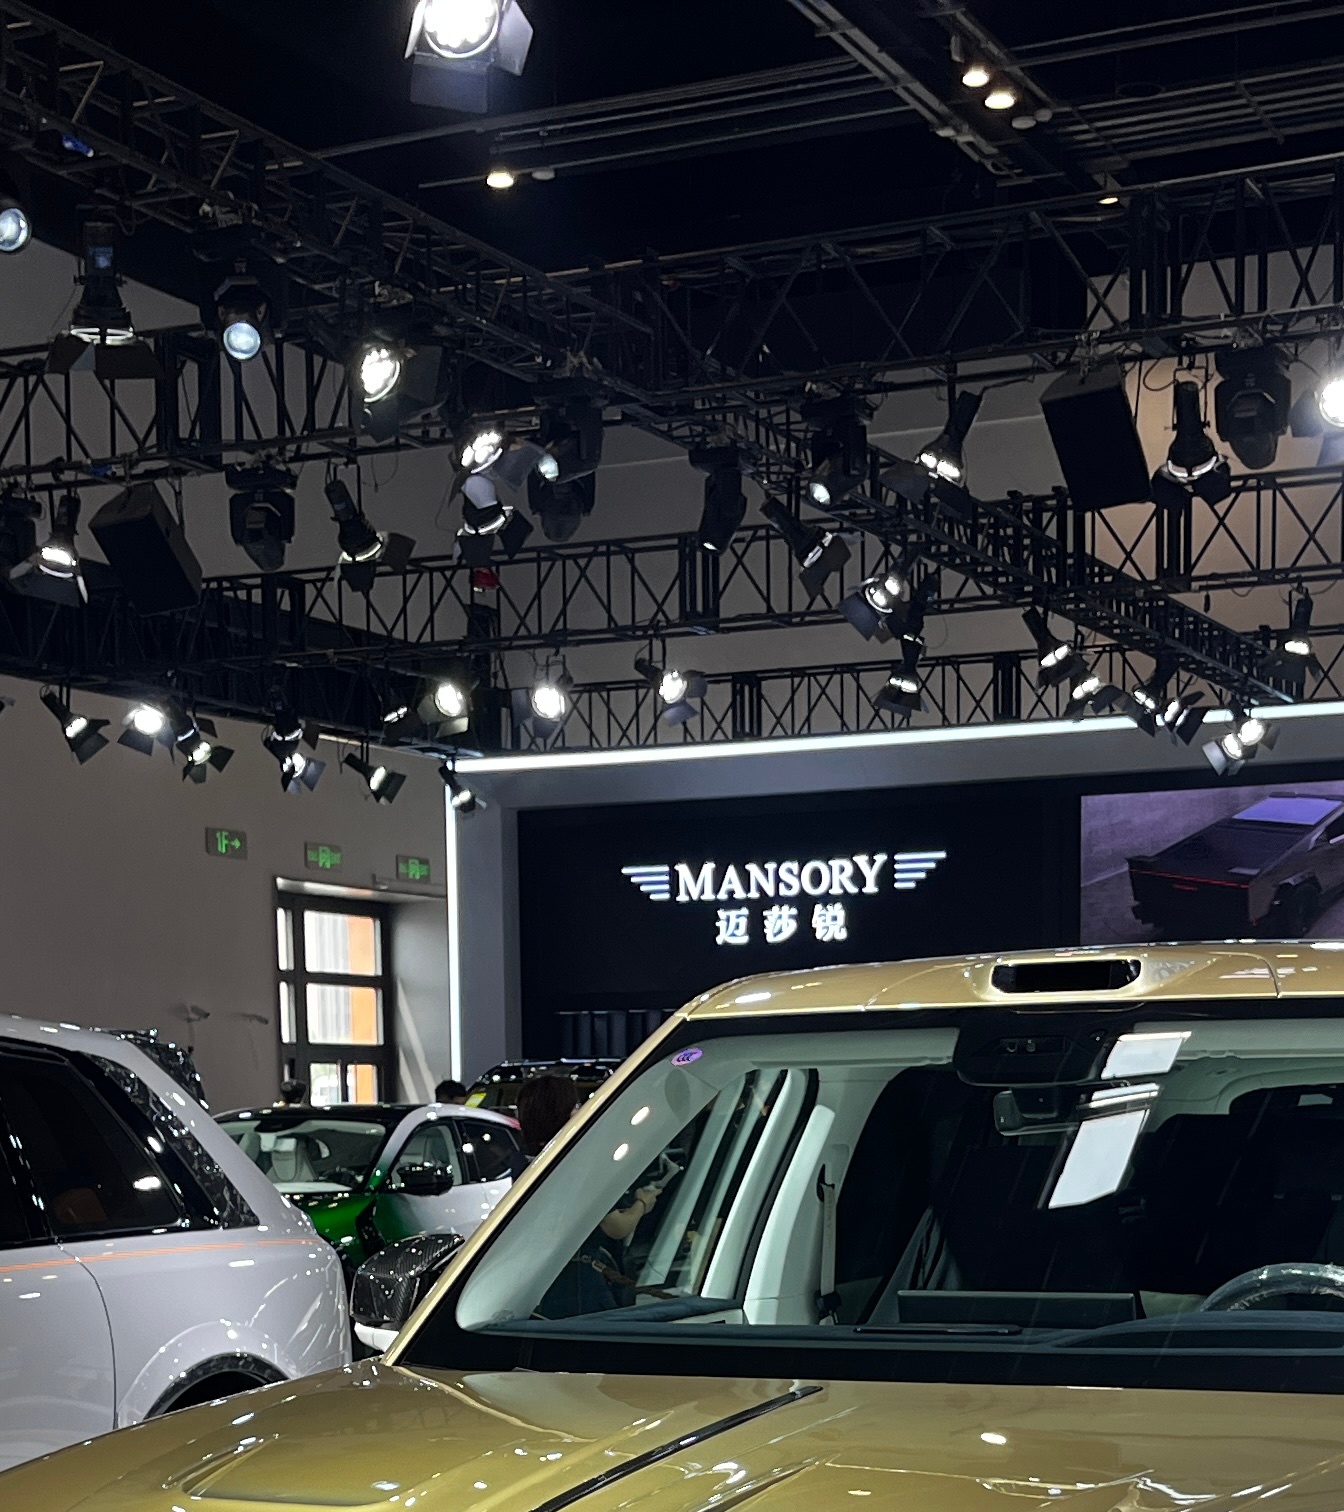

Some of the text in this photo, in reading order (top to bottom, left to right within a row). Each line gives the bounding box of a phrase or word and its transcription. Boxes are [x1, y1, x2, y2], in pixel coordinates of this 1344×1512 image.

[674, 853, 888, 902] MANSORY
[715, 902, 848, 945] 迈莎锐
